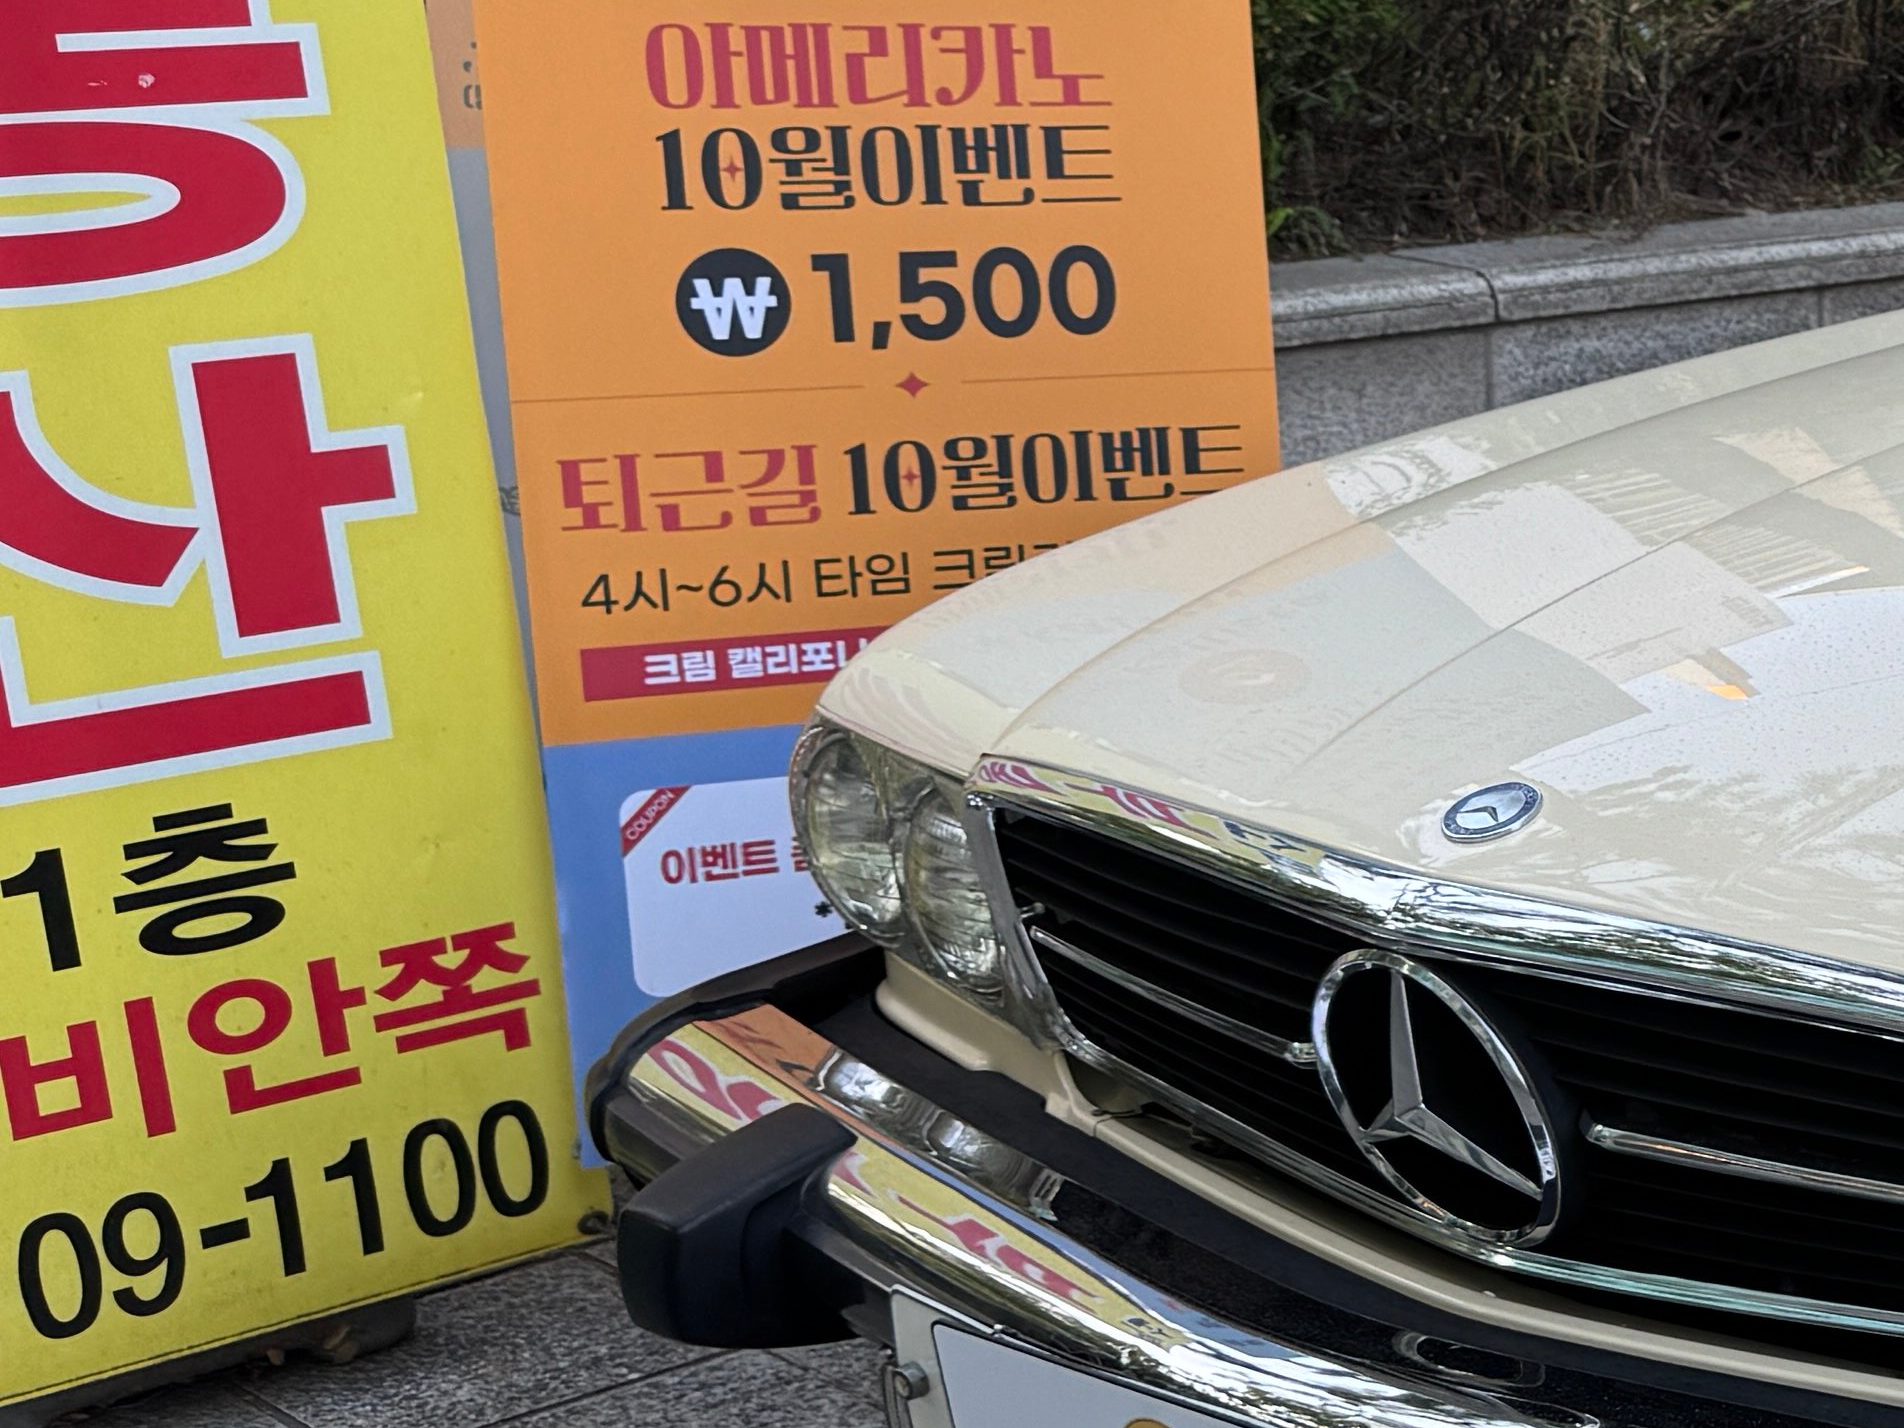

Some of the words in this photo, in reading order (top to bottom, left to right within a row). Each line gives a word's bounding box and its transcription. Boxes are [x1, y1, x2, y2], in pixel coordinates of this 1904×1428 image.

[645, 23, 1113, 110] 아메리카노
[655, 124, 1123, 212] 10월이벤트
[557, 445, 823, 533] 퇴근길
[843, 424, 1245, 517] 10월이벤트
[580, 559, 793, 616] 4시~6시
[813, 551, 911, 599] 타임
[932, 539, 1072, 591] 크림
[643, 648, 717, 686] 크림
[625, 788, 677, 841] COUPON
[0, 803, 297, 972] 1층
[660, 839, 780, 885] 이벤트
[0, 921, 542, 1141] 비안쪽
[18, 1099, 550, 1340] 09-1100
